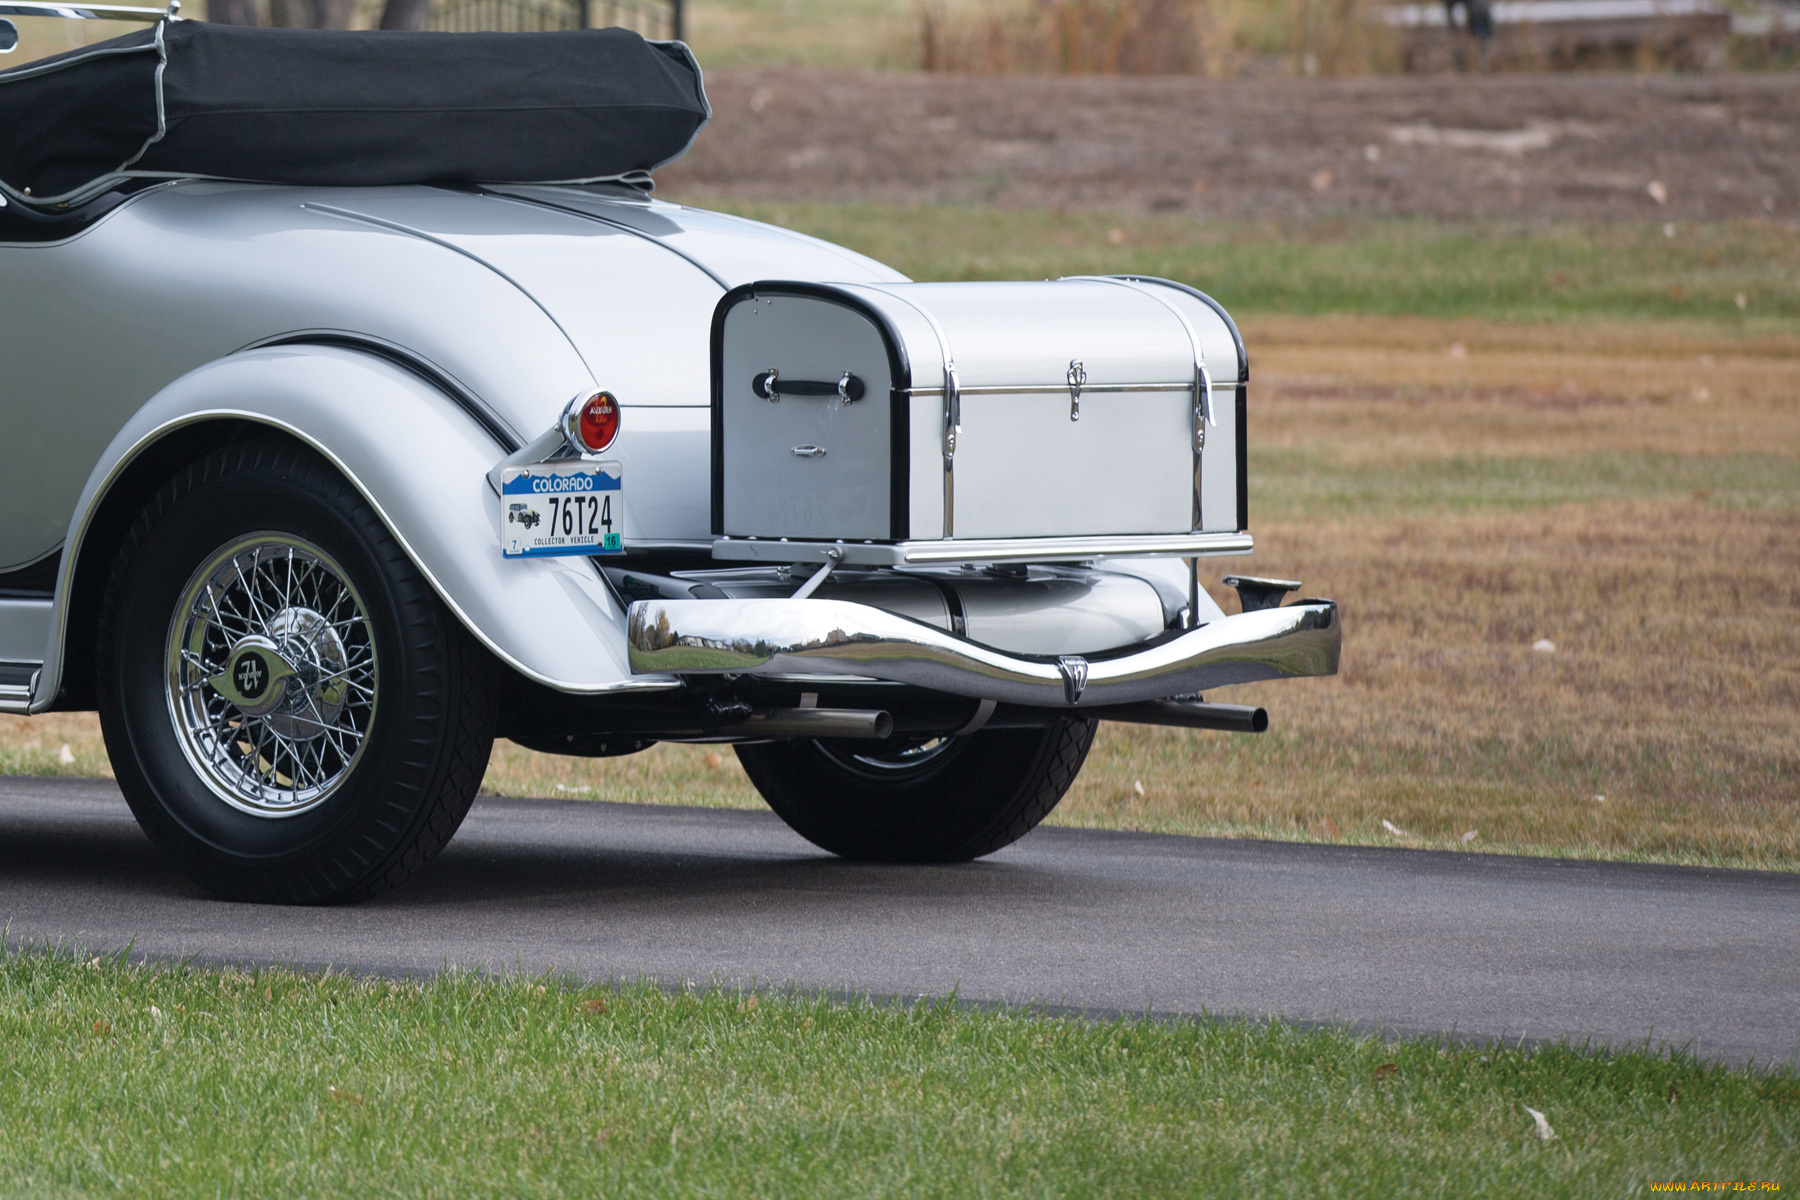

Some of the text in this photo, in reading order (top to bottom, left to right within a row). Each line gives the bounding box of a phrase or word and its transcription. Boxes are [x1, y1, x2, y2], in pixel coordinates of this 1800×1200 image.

[532, 477, 594, 493] COLORADO
[549, 495, 612, 537] 76T24
[511, 540, 518, 550] 7
[534, 535, 595, 546] COLLECTOR VEHICLE
[606, 535, 617, 547] 16
[240, 659, 259, 691] 12
